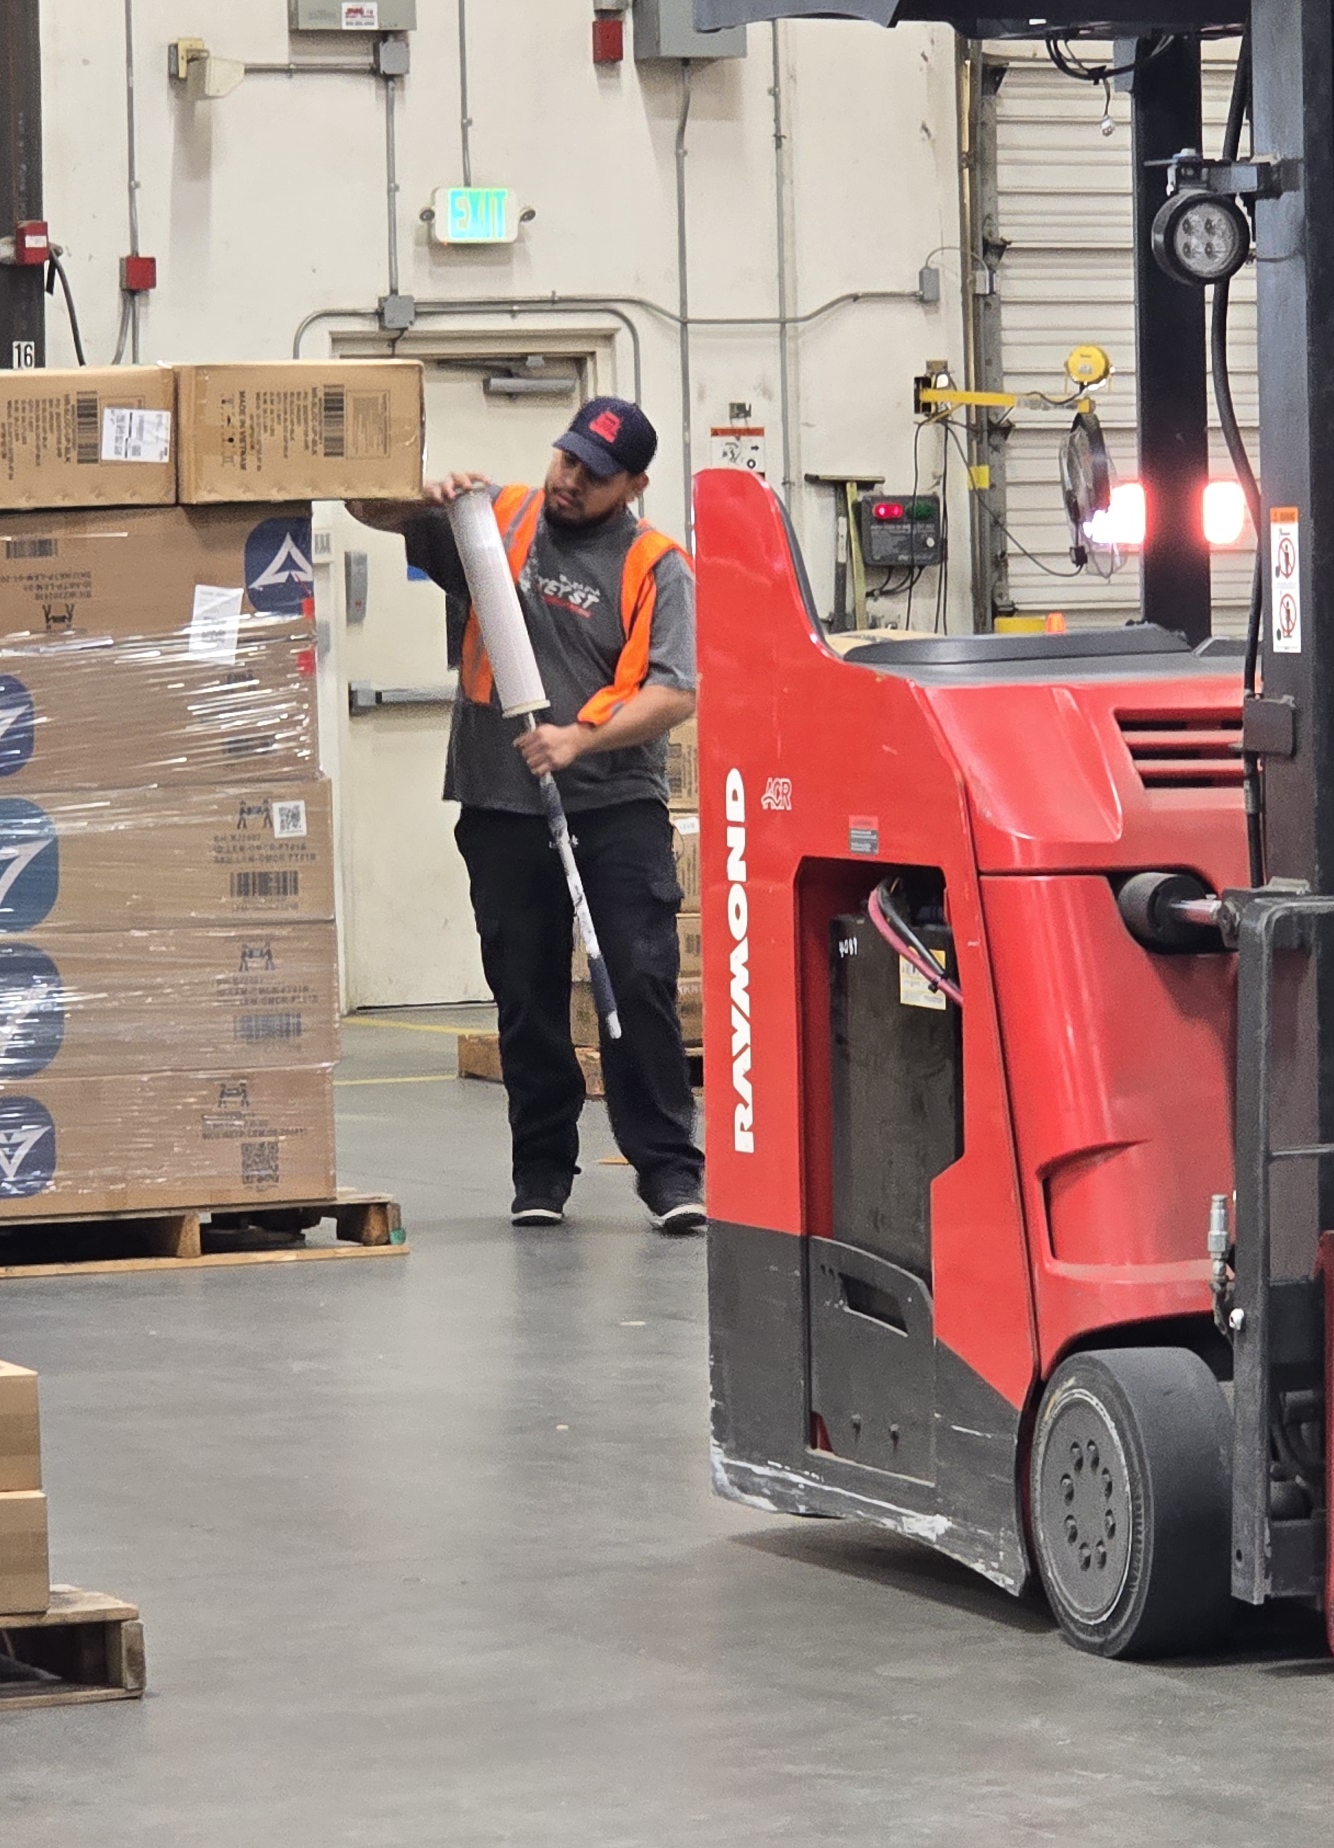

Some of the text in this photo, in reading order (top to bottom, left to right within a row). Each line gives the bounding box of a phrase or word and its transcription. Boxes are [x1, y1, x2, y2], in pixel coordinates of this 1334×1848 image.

[449, 190, 506, 238] EXIT
[13, 343, 34, 368] 16
[760, 777, 793, 811] ACR
[724, 767, 755, 1154] RAYMOND
